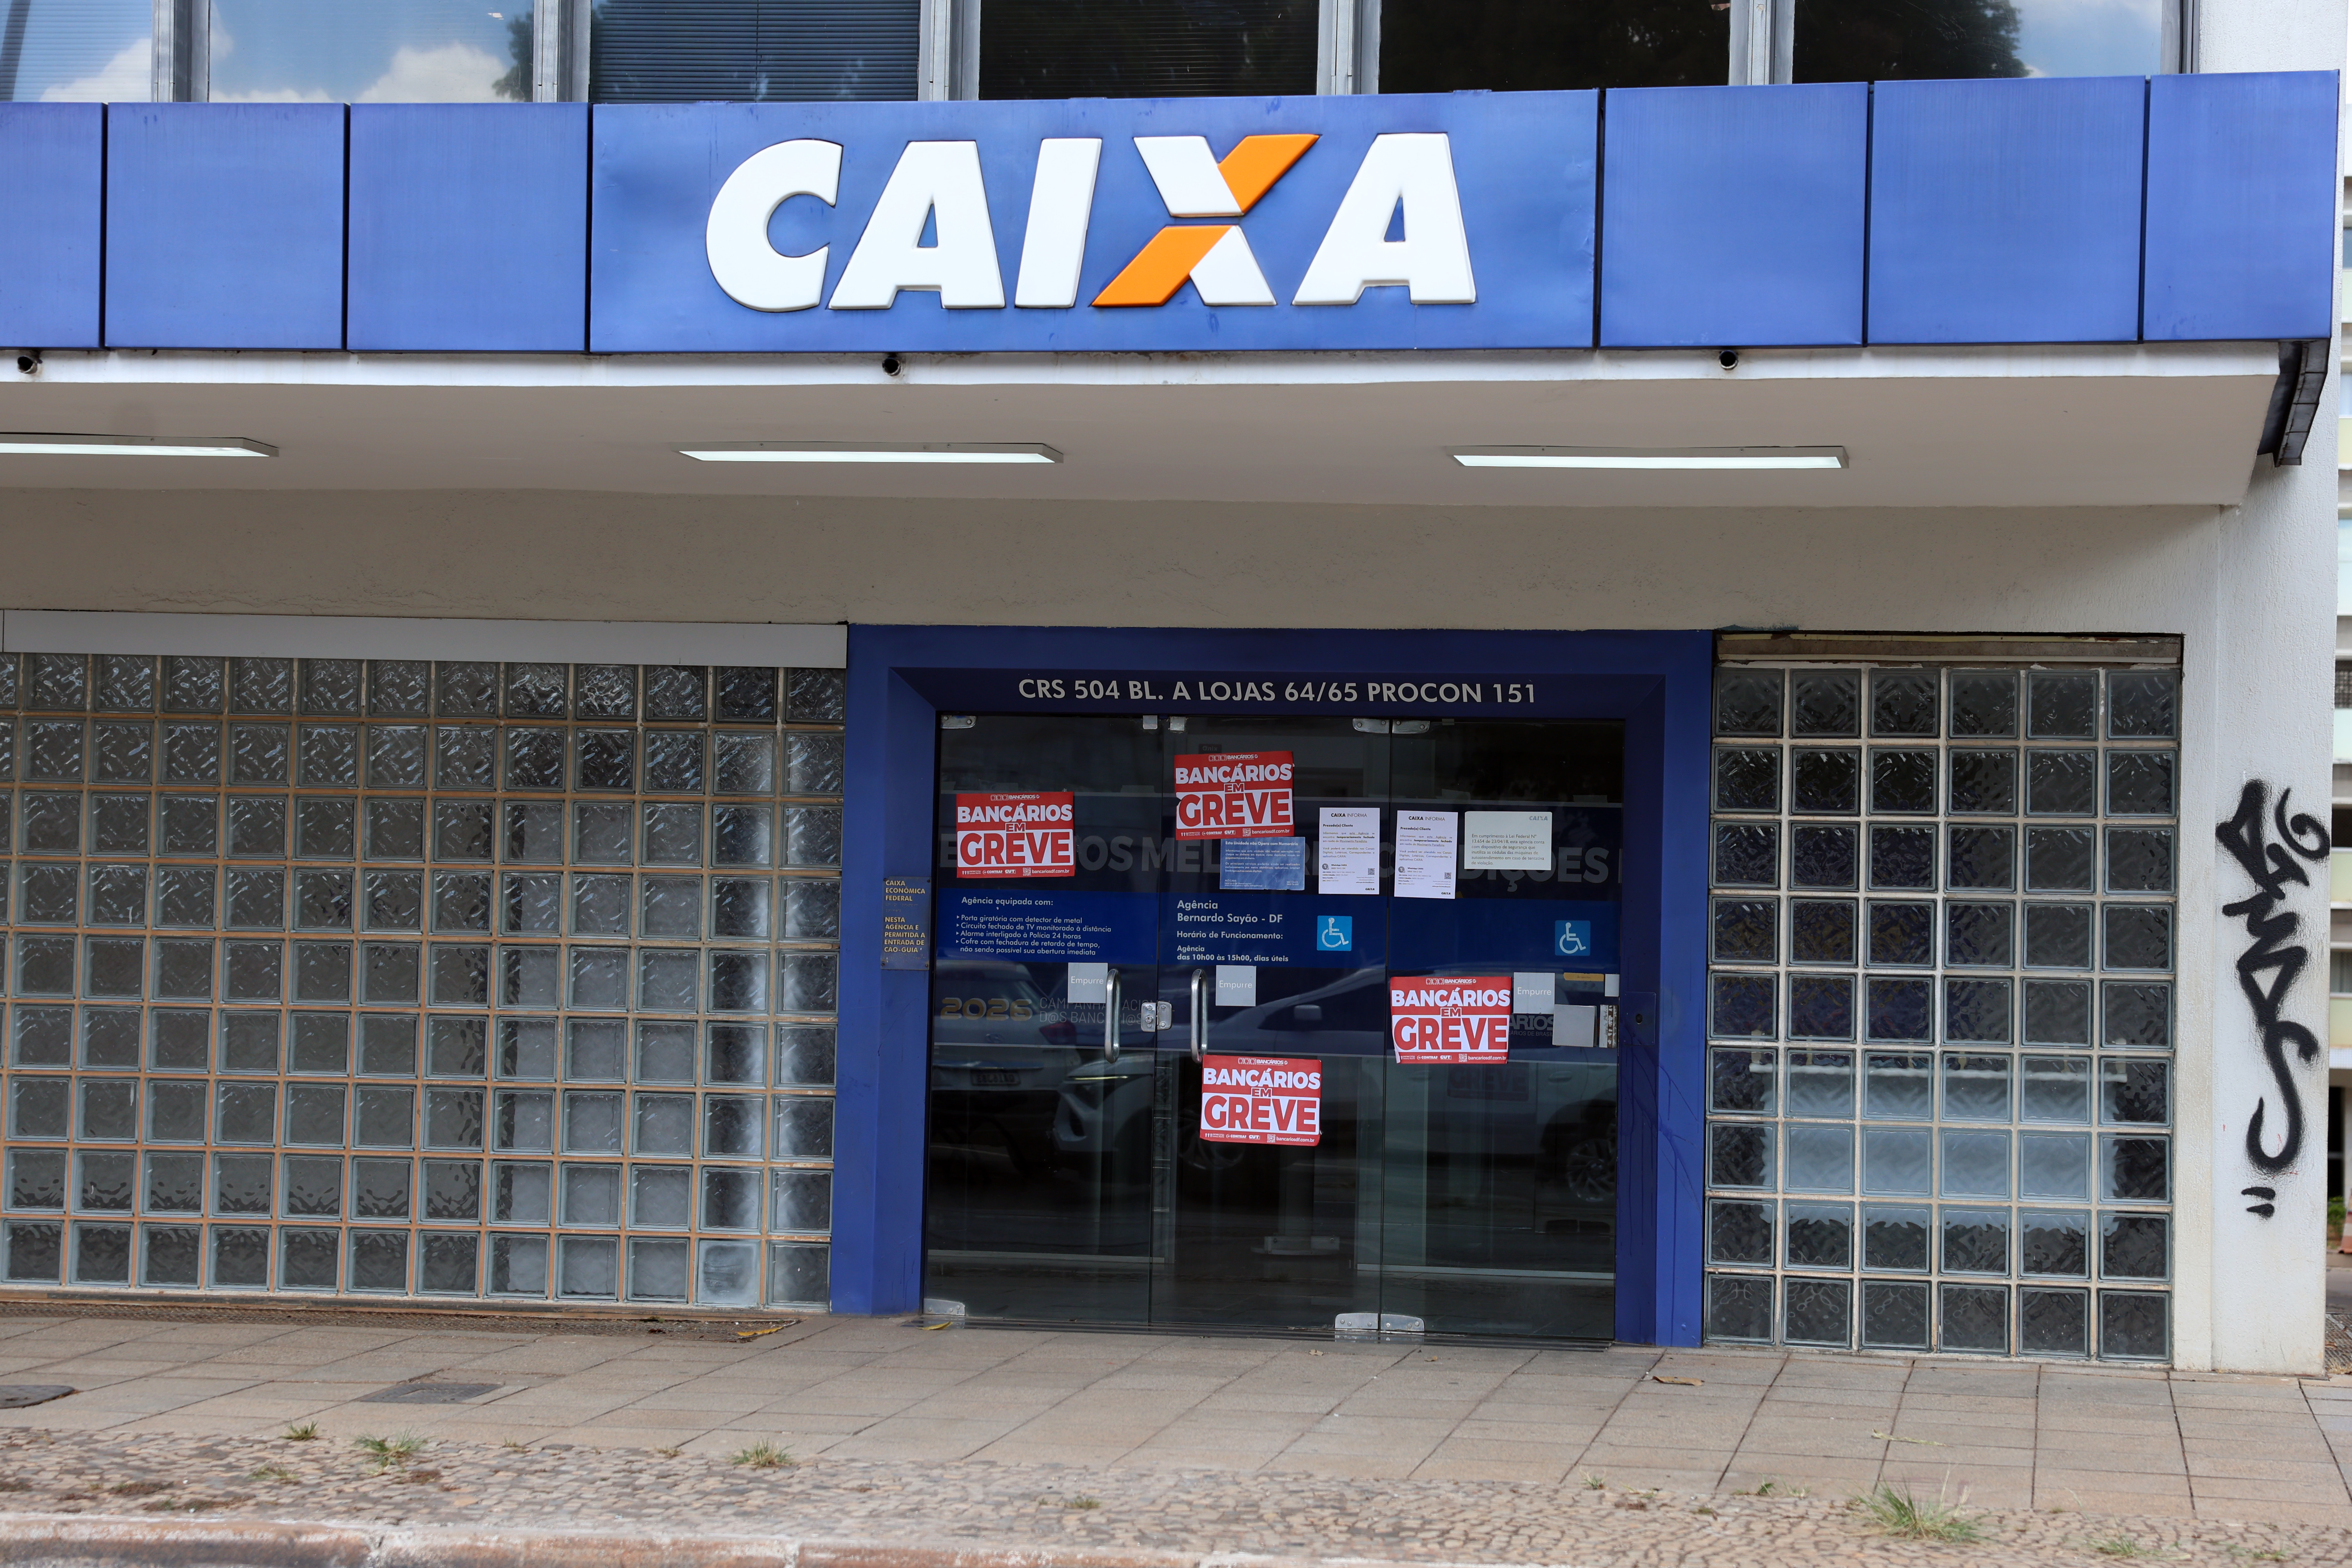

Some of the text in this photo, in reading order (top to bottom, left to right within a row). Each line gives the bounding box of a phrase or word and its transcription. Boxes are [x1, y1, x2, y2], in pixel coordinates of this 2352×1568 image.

[706, 133, 1476, 312] CAIXA
[1019, 679, 1534, 702] CRS 504 BL. A LOJAS 64/65 PROCON 151
[1176, 763, 1292, 784] BANCÁRIOS
[1225, 783, 1244, 792] EM
[958, 803, 1073, 822] BANCÁRIOS
[1179, 791, 1290, 827] GREVE
[1006, 823, 1025, 832] EM
[960, 832, 1070, 865] GREVE
[961, 897, 993, 905] Agência
[995, 897, 1032, 906] equipada
[1177, 900, 1218, 911] Agência
[1178, 913, 1223, 922] Bernardo
[1227, 913, 1258, 924] Sayão
[1269, 914, 1282, 922] DF
[1071, 976, 1104, 986] Empurre
[1219, 980, 1253, 990] Empurre
[1392, 987, 1510, 1007] BANCÁRIOS
[1517, 987, 1552, 997] Empurre
[940, 997, 1033, 1021] 2026
[1441, 1007, 1461, 1017] EM
[1040, 1011, 1067, 1023] D@S
[1394, 1017, 1507, 1050] GREVE
[1203, 1068, 1321, 1089] BANCÁRIOS
[1252, 1088, 1272, 1097] EM
[1204, 1095, 1317, 1132] GREVE
